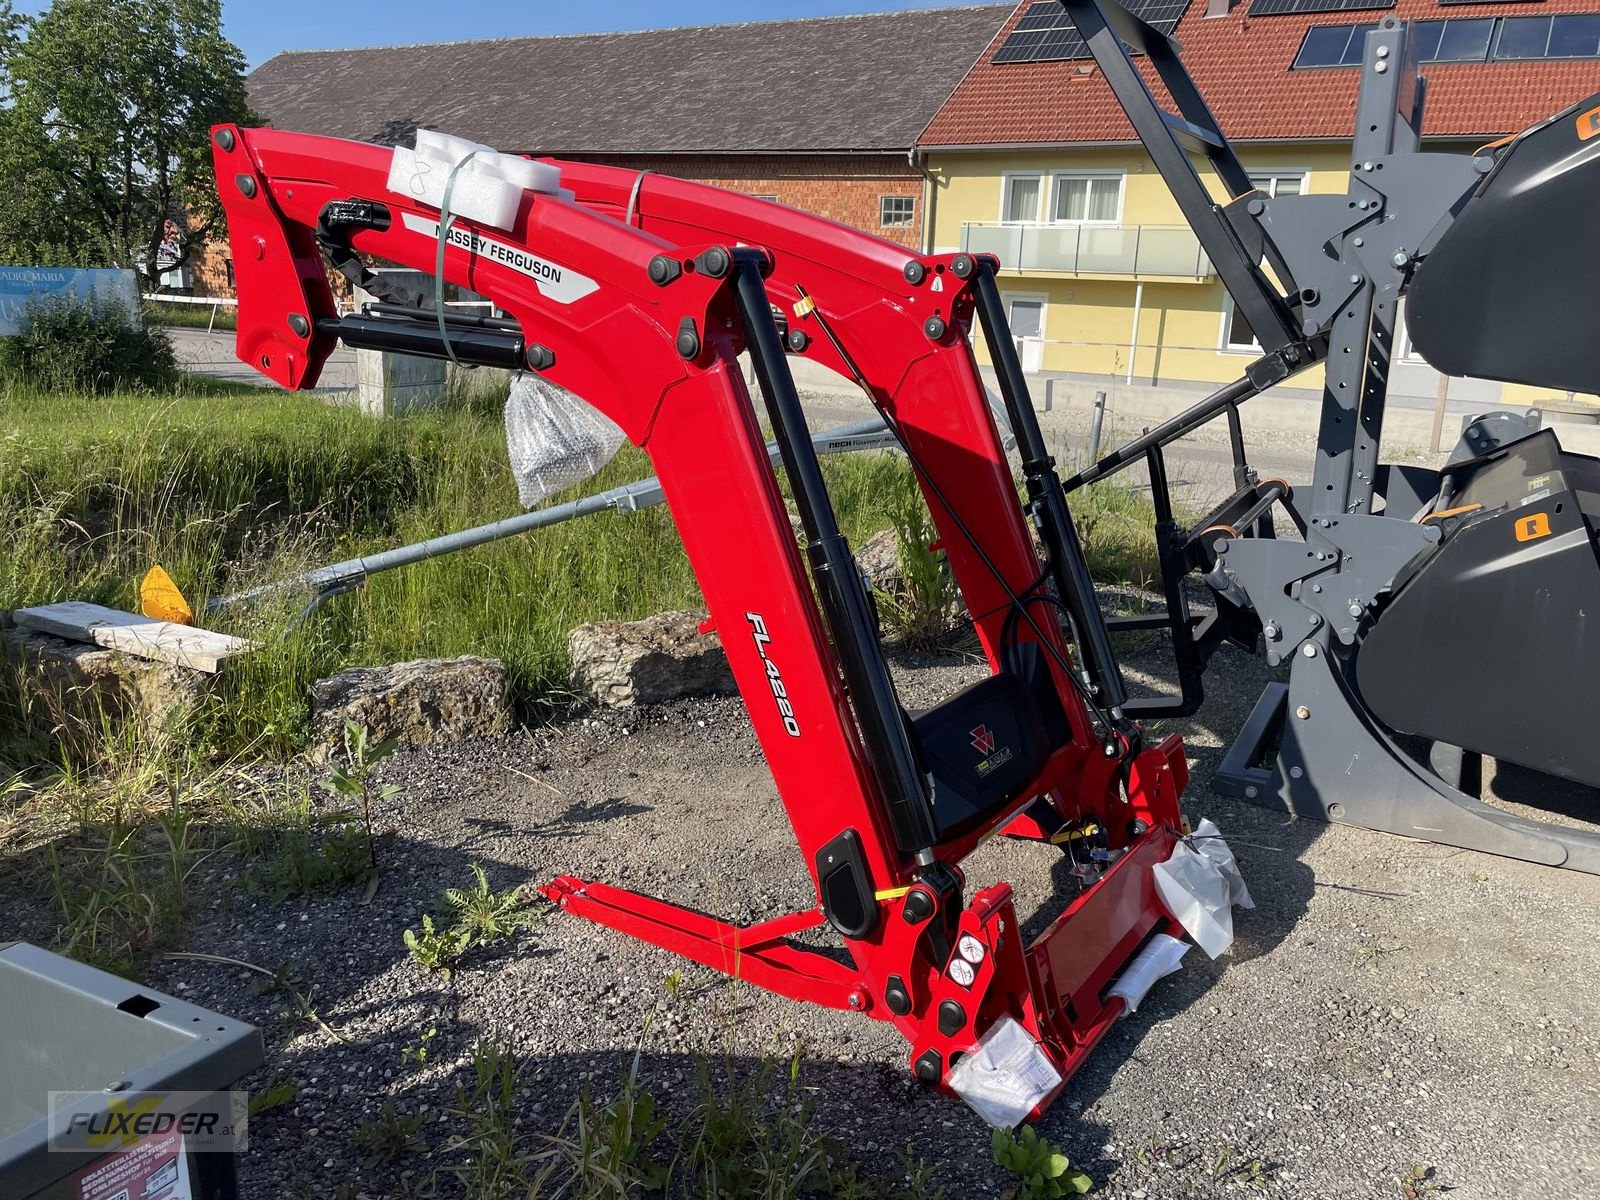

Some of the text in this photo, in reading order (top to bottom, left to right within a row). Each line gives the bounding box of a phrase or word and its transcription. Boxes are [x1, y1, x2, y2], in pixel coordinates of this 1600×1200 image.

[0, 271, 65, 281] ADIO MARIA
[490, 244, 562, 283] FERGUSON
[745, 611, 801, 737] FL.4220
[91, 1163, 142, 1195] ONLINESHOP
